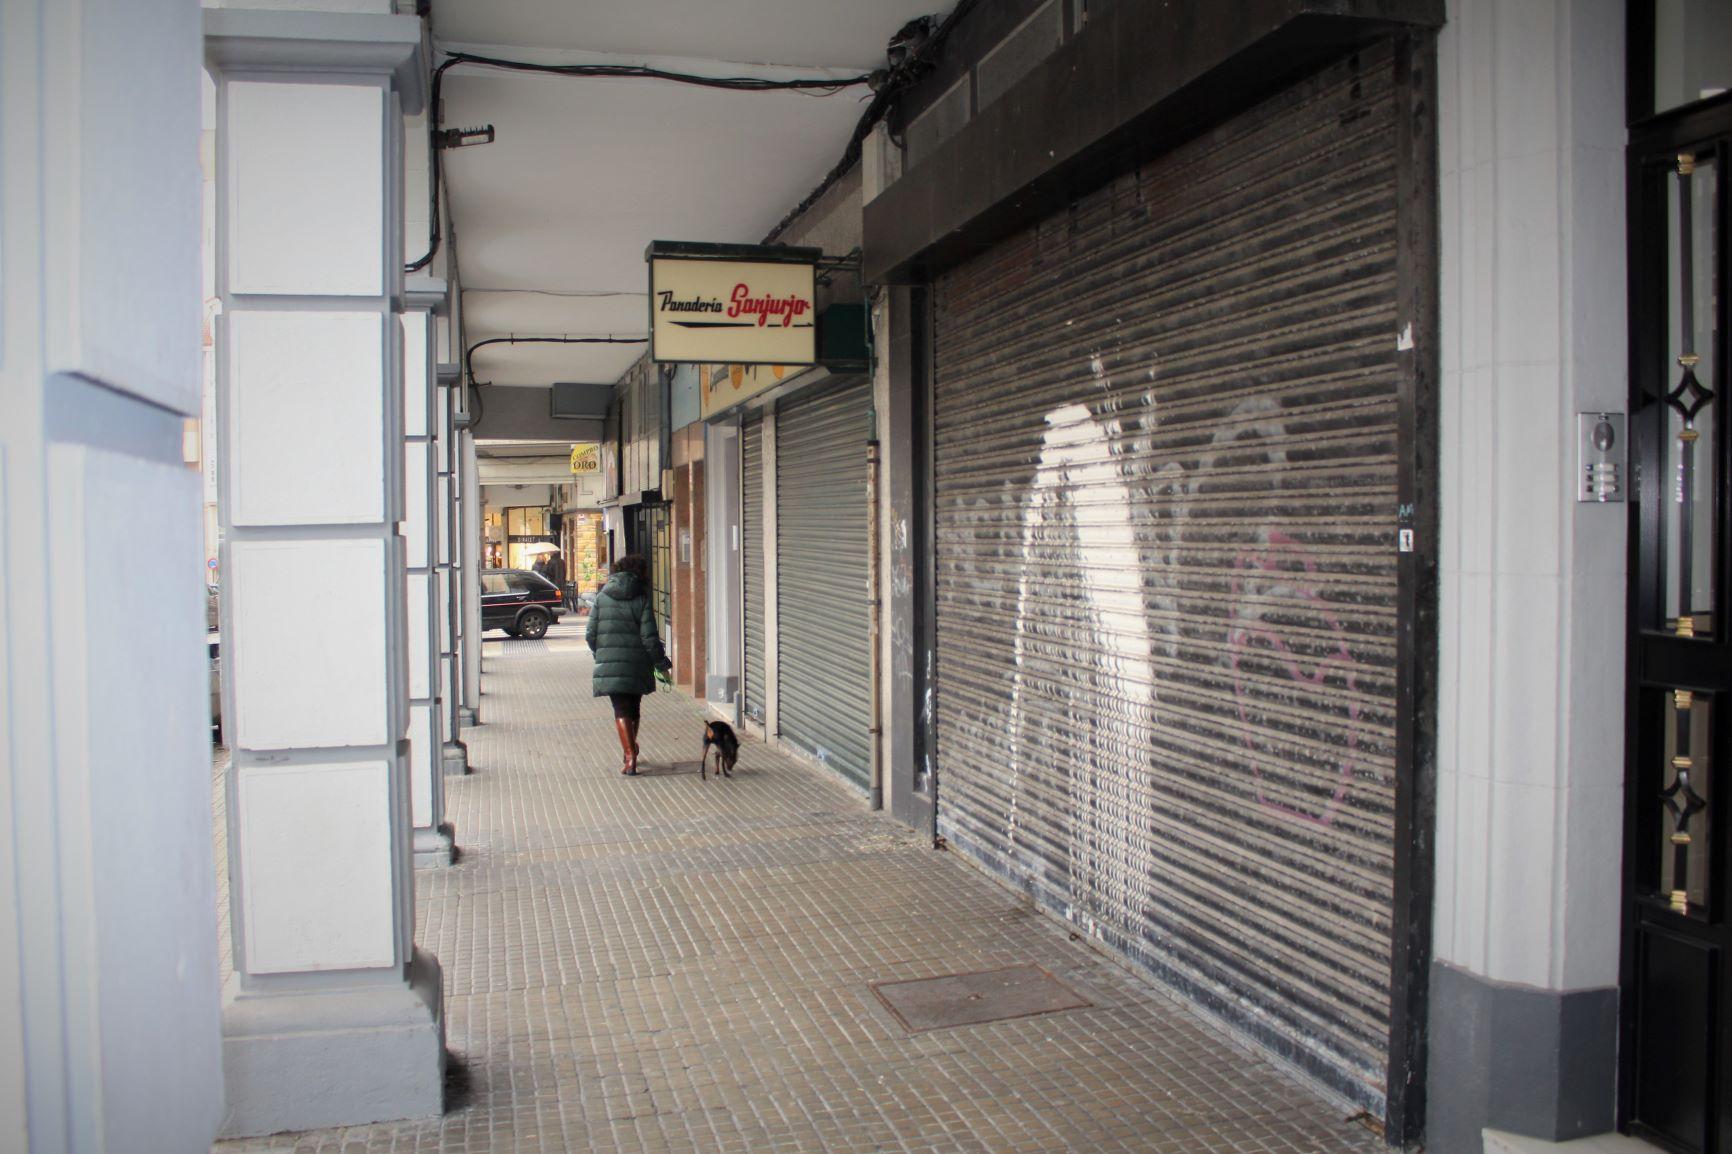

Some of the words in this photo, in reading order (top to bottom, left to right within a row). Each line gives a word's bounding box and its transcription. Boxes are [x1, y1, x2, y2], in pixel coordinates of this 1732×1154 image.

[727, 283, 809, 327] Sanjurjo
[572, 445, 599, 460] COMPRO
[573, 460, 597, 470] ORO
